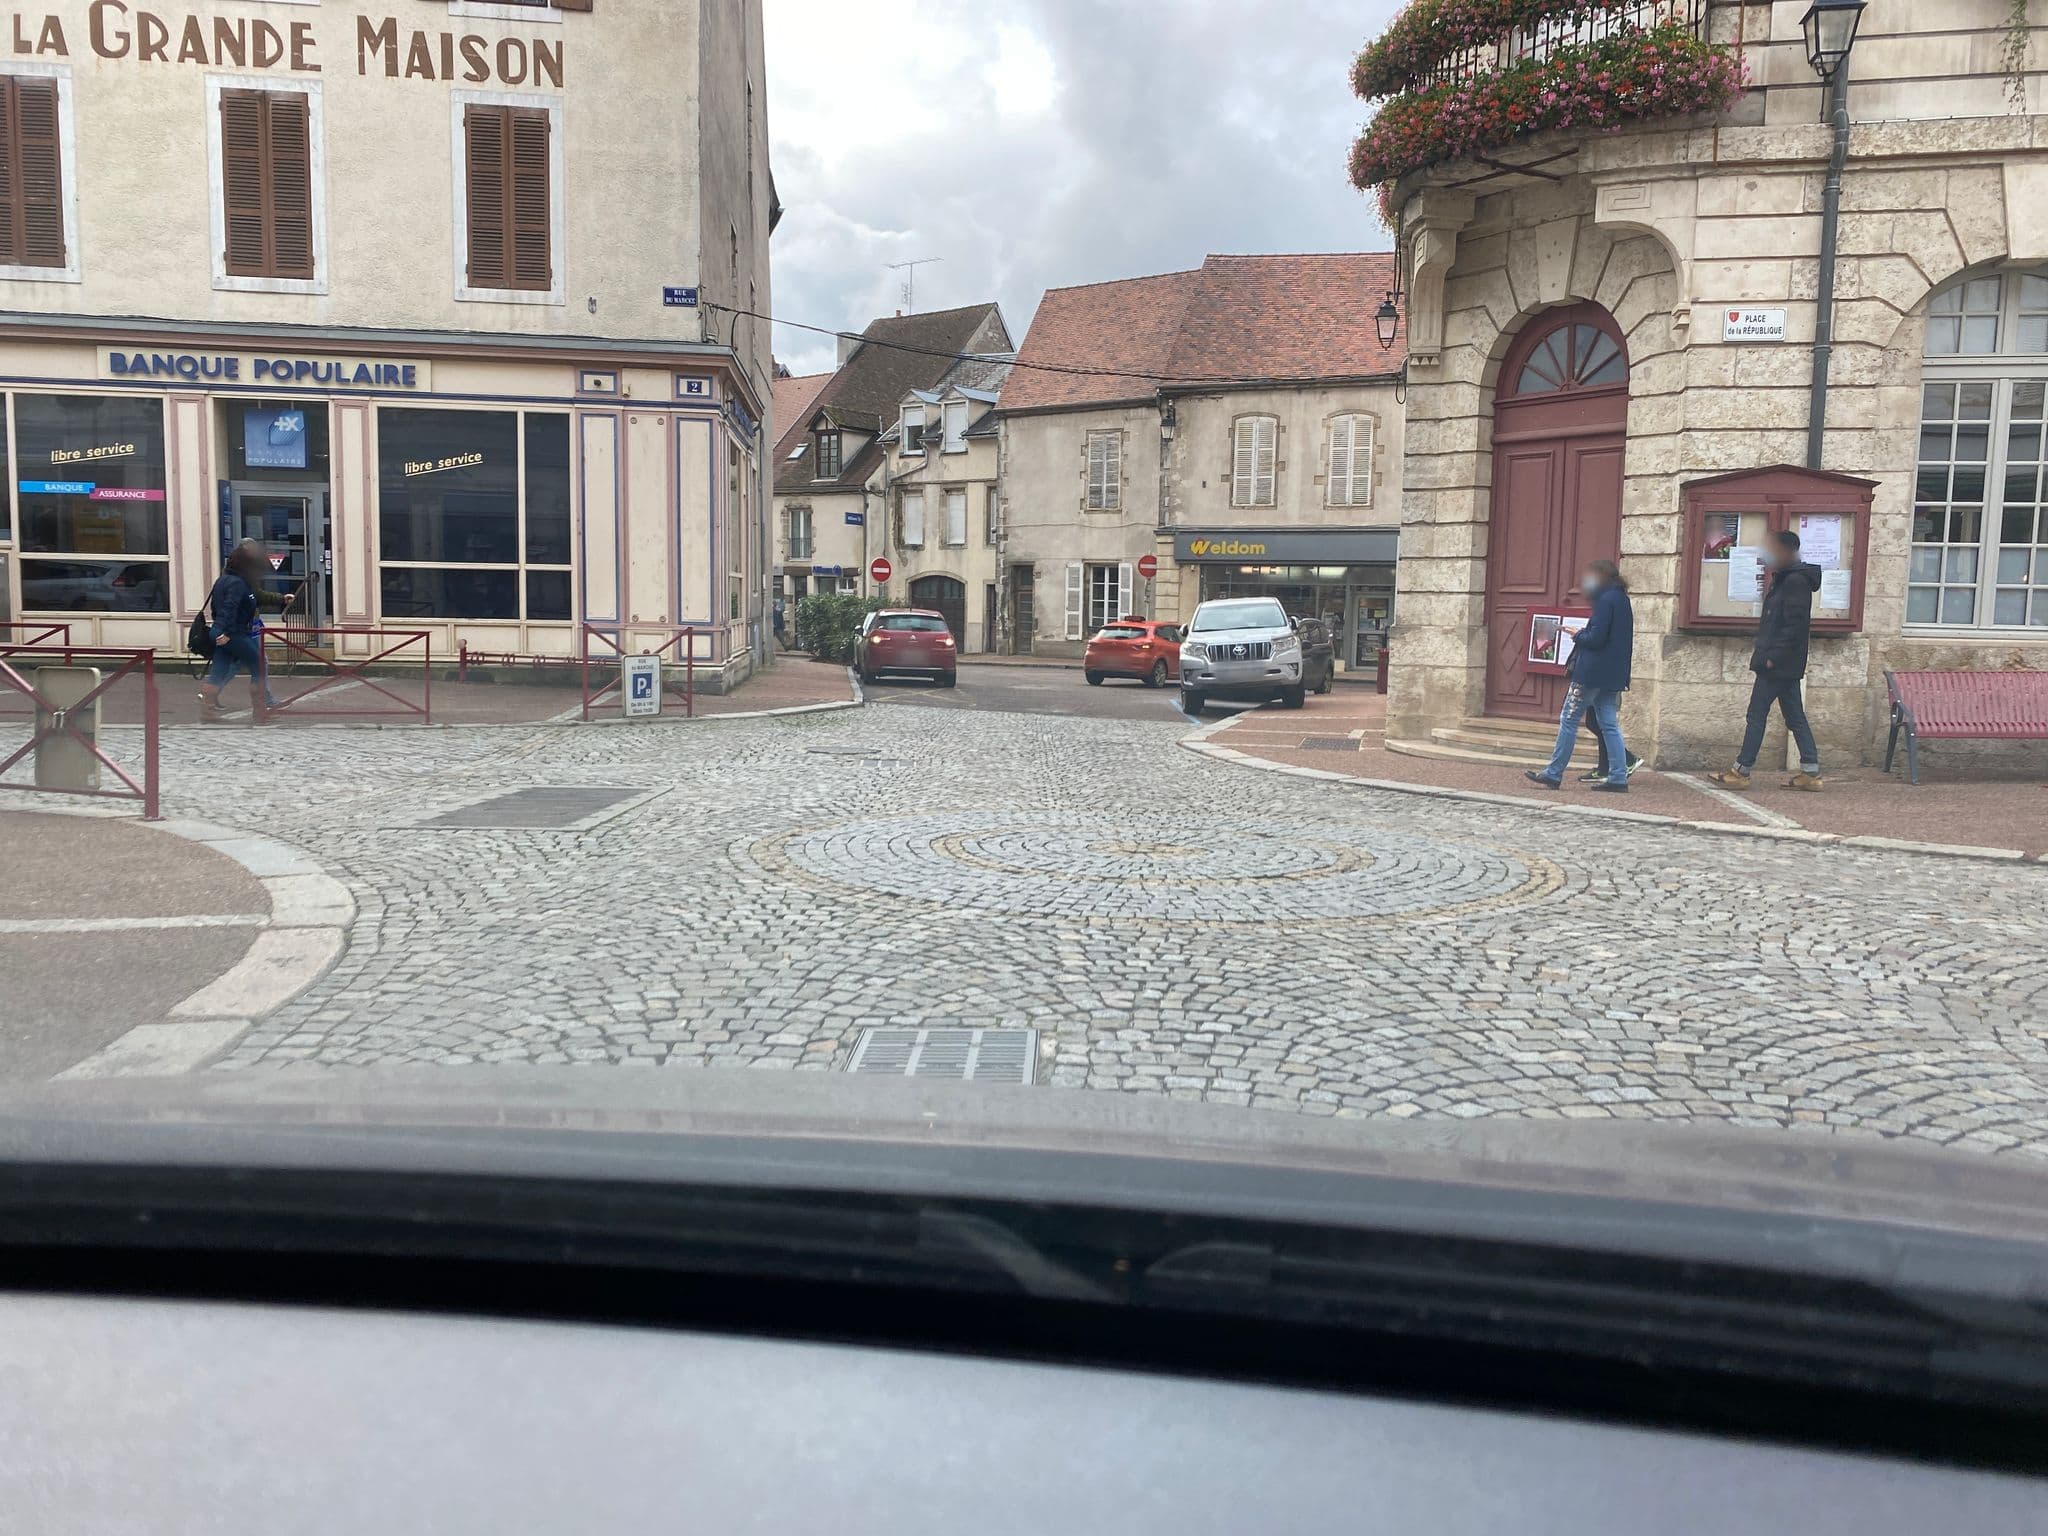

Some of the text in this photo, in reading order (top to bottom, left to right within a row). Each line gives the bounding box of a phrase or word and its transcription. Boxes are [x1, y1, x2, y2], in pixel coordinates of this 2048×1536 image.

[13, 0, 563, 88] LA GRANDE MAISON
[1745, 314, 1767, 323] PLACE
[1728, 325, 1783, 335] de la RÉPUBLIQUE
[109, 352, 417, 386] BANQUE POPULAIRE
[691, 382, 699, 392] 2
[51, 442, 134, 462] libre service
[404, 452, 482, 474] libre service
[44, 483, 84, 492] BANQUE
[98, 490, 147, 499] ASSURANCE
[1190, 540, 1265, 555] Weldom
[637, 677, 647, 695] P
